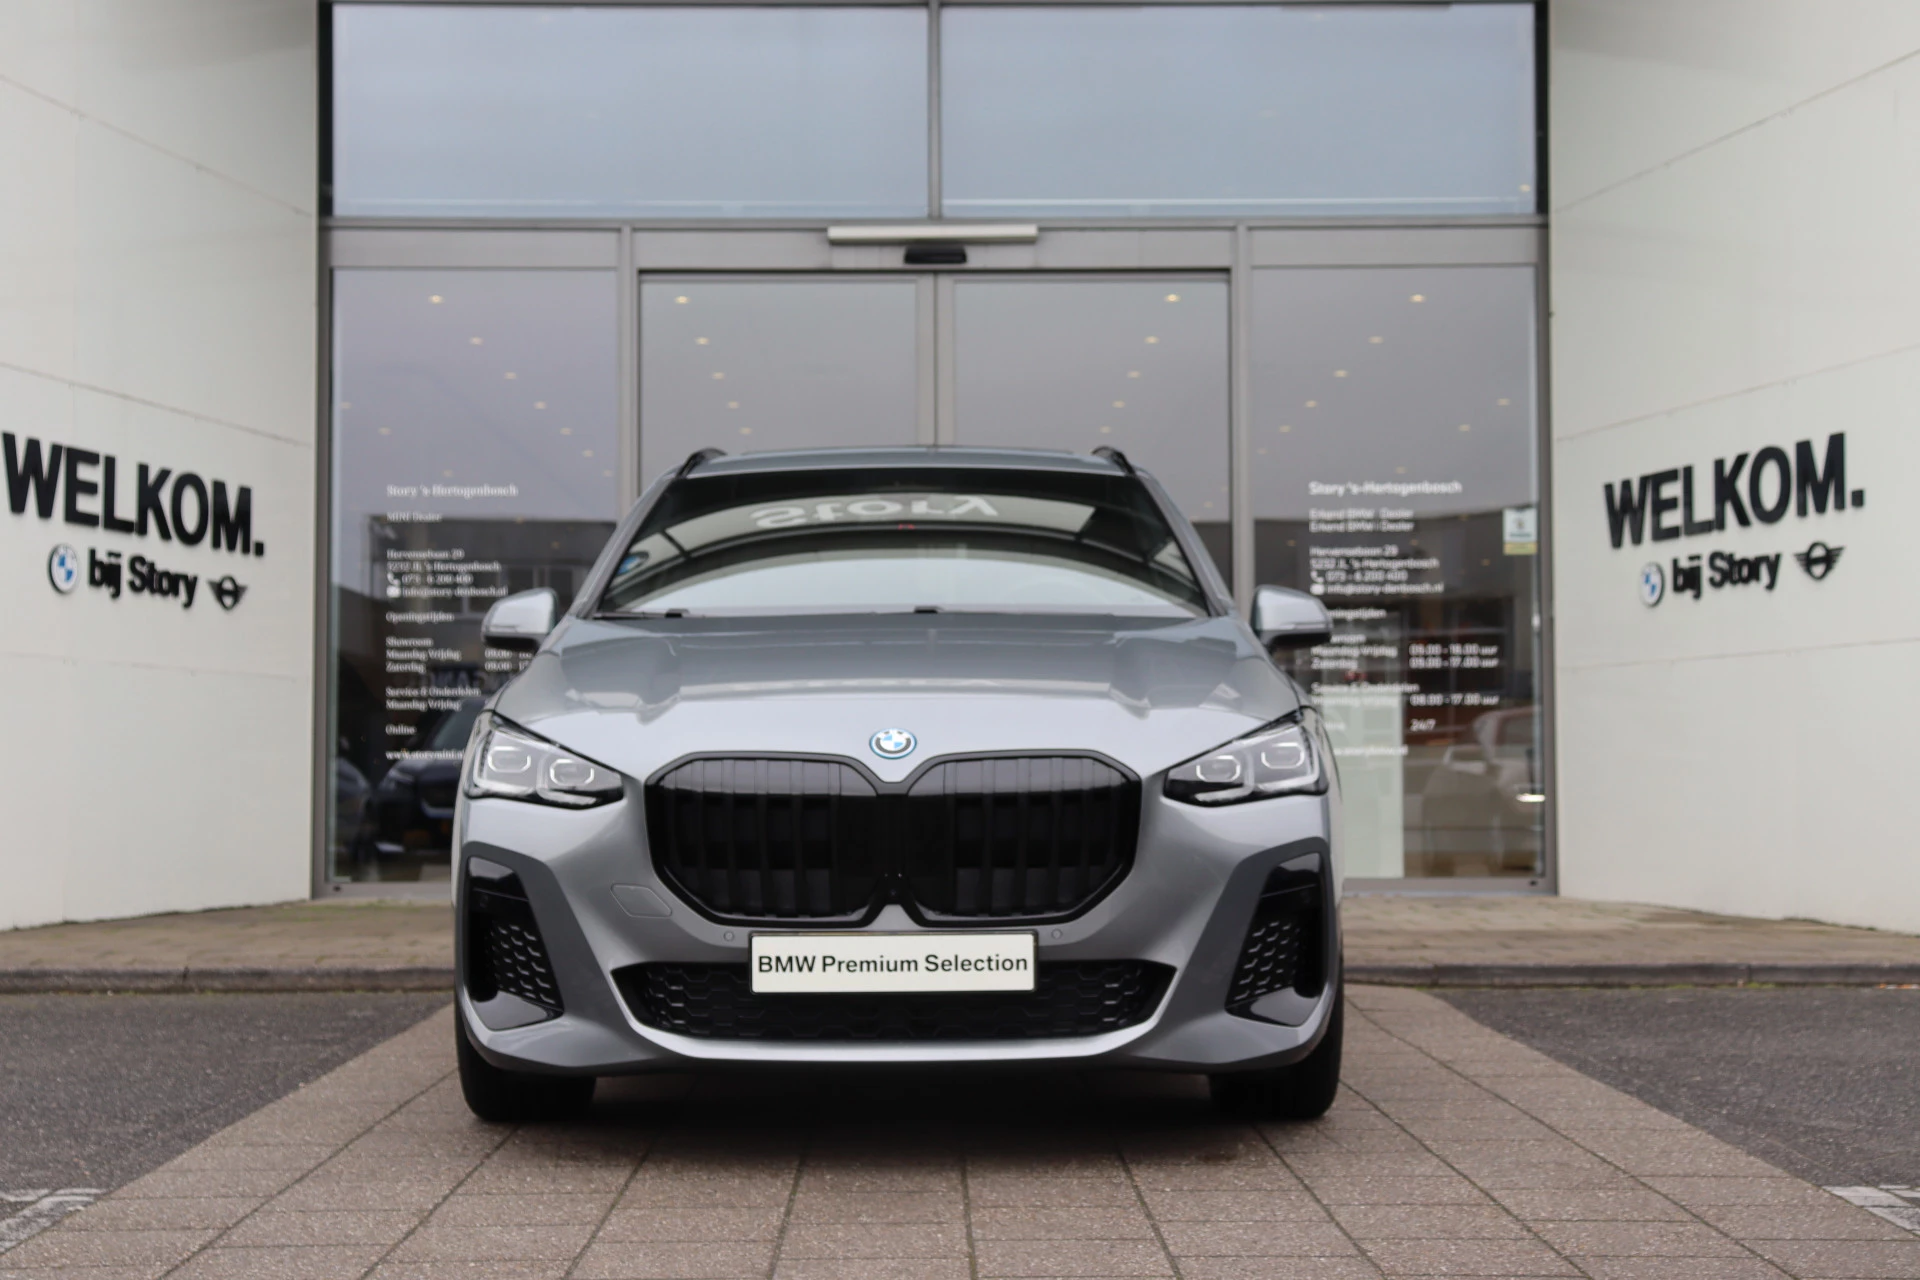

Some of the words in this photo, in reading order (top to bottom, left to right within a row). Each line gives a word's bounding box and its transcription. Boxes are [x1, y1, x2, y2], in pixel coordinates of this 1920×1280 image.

[1, 430, 265, 557] WELKOM.
[387, 484, 417, 500] Story
[1308, 481, 1345, 497] Story
[1603, 431, 1865, 550] WELKOM.
[128, 555, 198, 609] Story
[1708, 551, 1781, 591] Story
[386, 636, 433, 648] Showroom
[758, 954, 816, 974] BMW
[822, 954, 918, 974] Premium
[924, 952, 1028, 973] Selection
